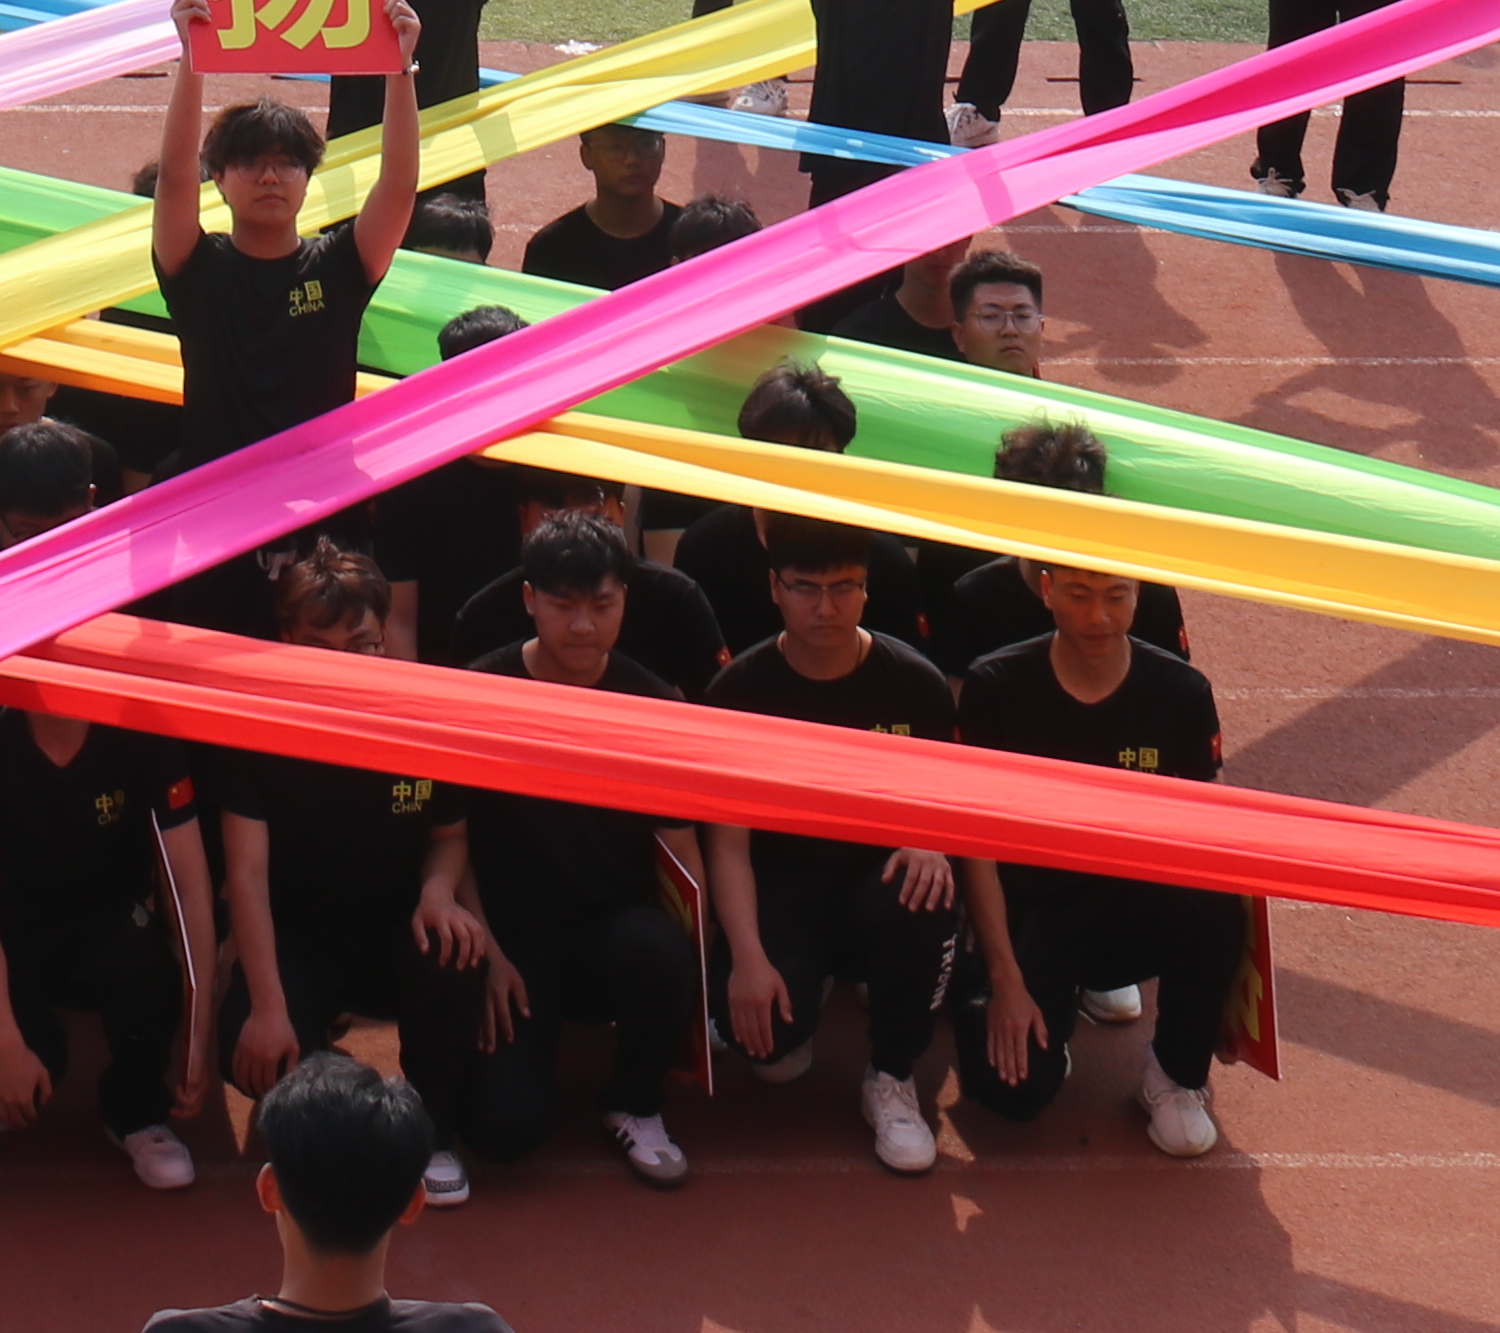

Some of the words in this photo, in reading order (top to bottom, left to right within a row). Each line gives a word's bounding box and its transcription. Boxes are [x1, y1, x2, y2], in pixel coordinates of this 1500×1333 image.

[288, 279, 323, 306] 中国
[288, 300, 326, 317] CHINA
[1118, 746, 1159, 769] 中国
[391, 779, 433, 803] 中国
[390, 800, 423, 814] CHIN
